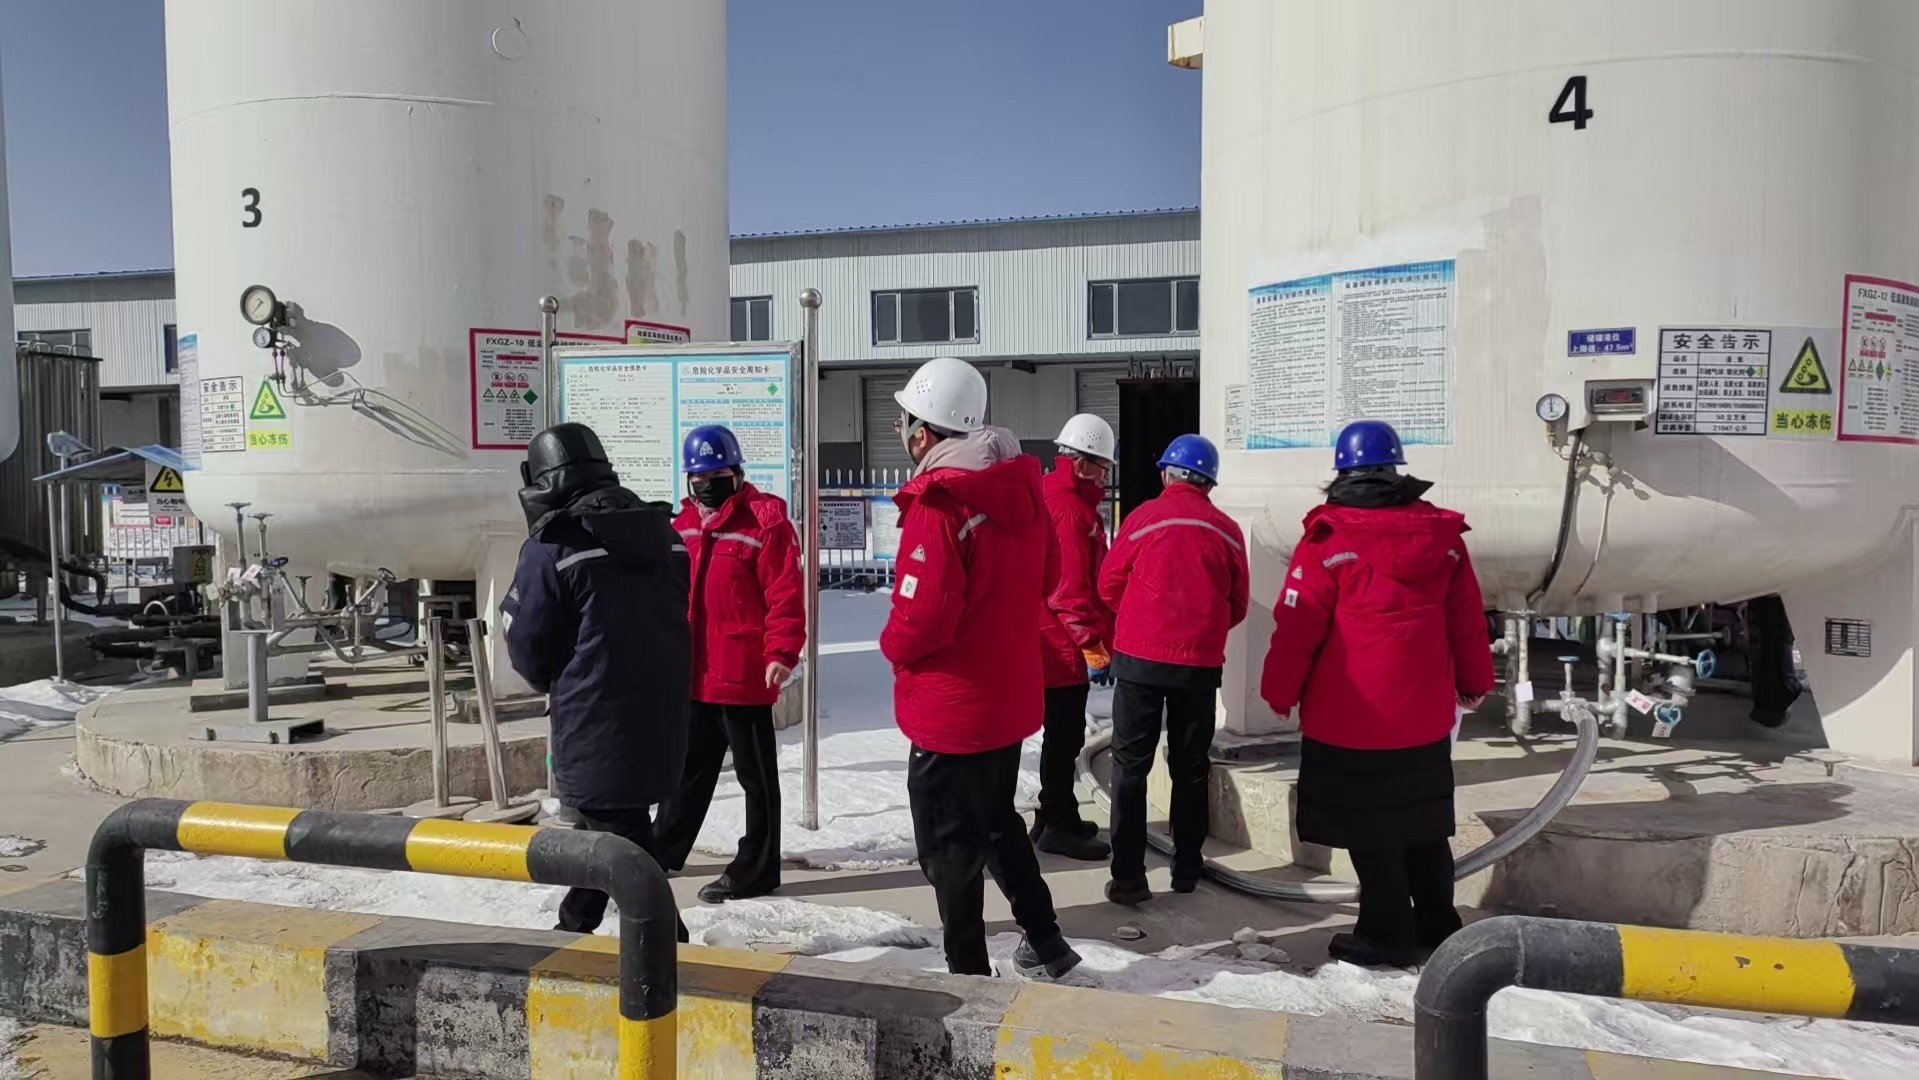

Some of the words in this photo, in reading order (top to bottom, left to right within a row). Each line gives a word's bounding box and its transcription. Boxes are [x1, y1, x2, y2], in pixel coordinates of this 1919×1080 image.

[1549, 75, 1593, 130] 4
[242, 187, 262, 228] 3
[1858, 288, 1888, 301] FXGZ-12
[486, 338, 524, 346] FXGZ-10
[1673, 333, 1760, 350] 安全告示
[692, 365, 770, 375] 危险化学品安全周知卡
[1776, 413, 1832, 430] 当心冻伤
[249, 433, 289, 446] 当心冻伤
